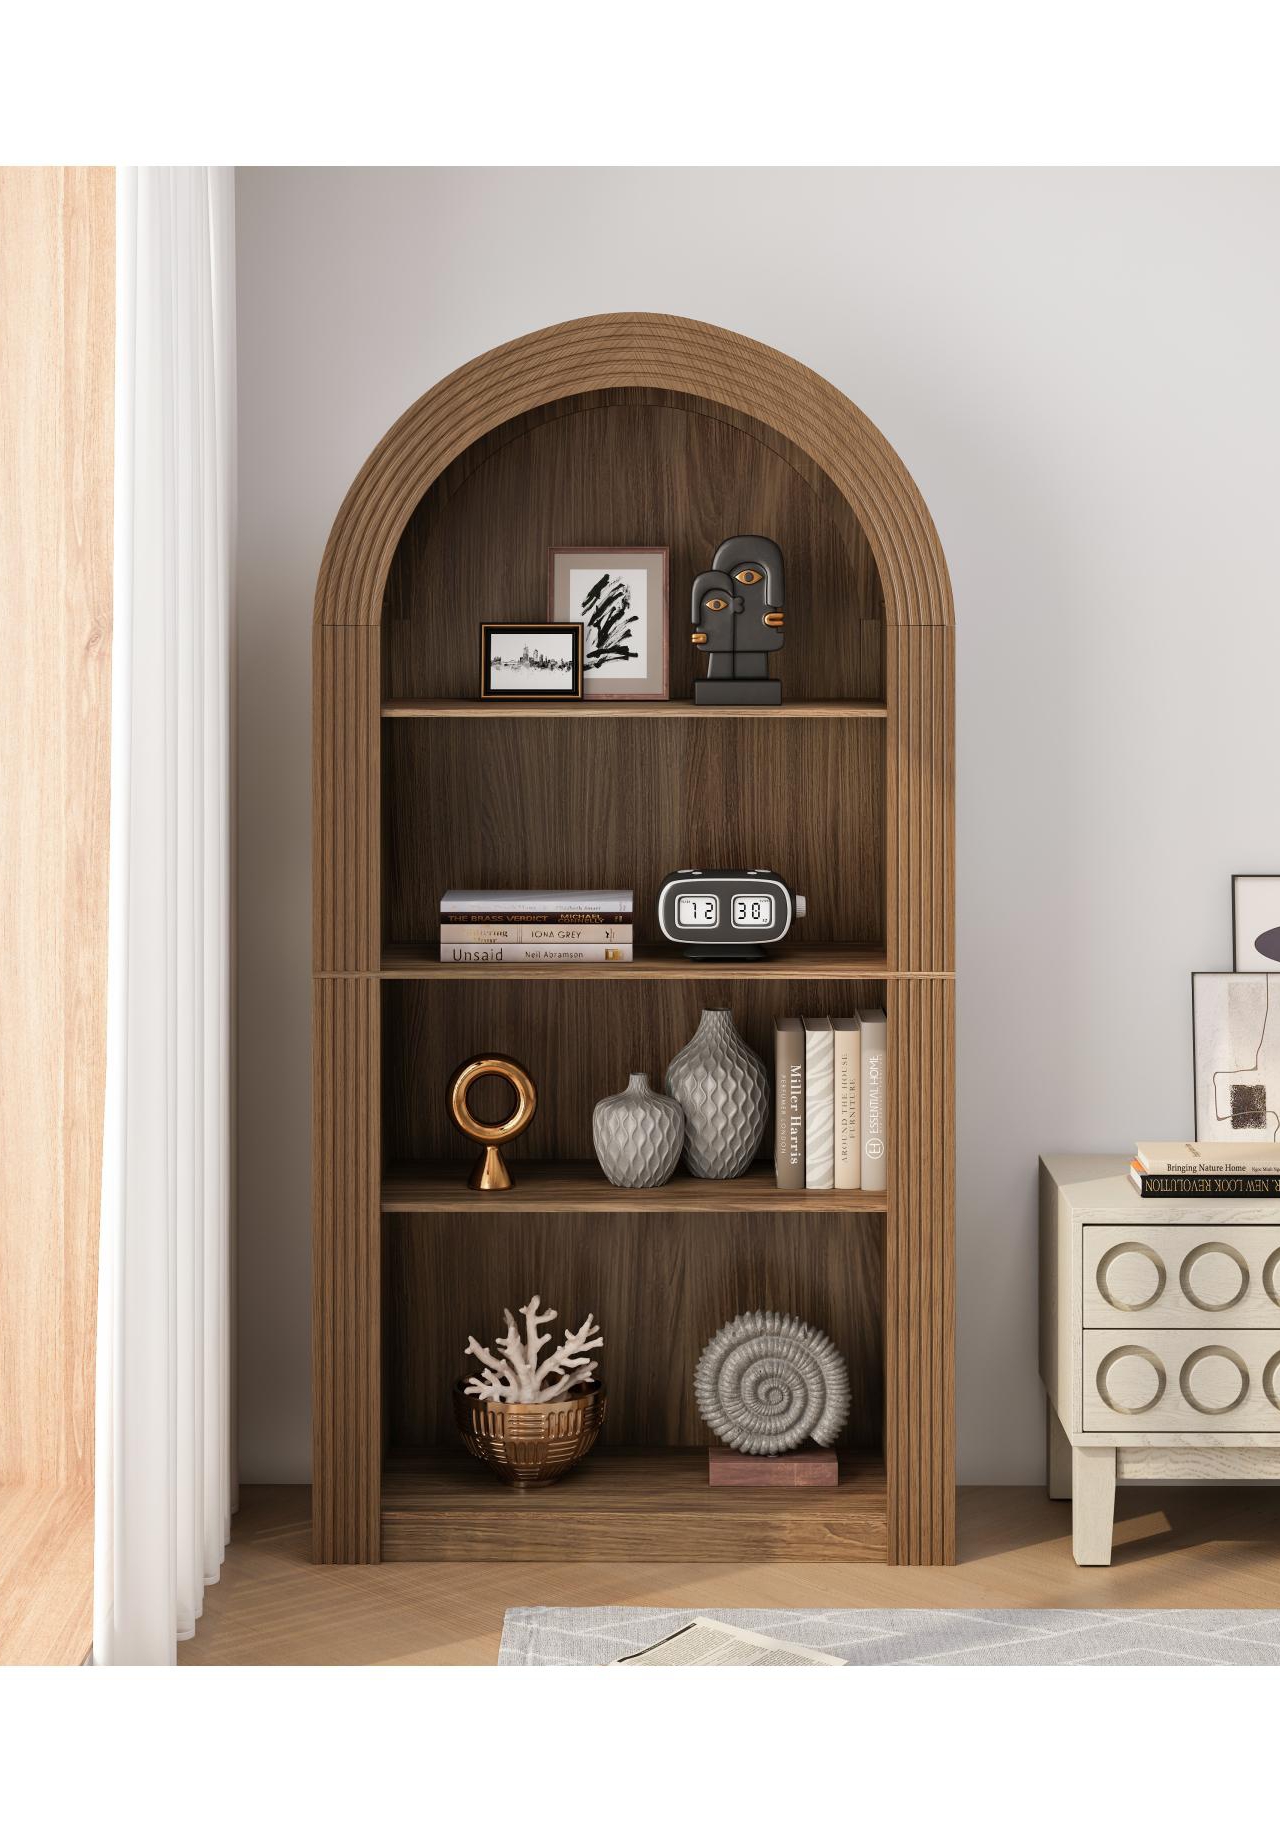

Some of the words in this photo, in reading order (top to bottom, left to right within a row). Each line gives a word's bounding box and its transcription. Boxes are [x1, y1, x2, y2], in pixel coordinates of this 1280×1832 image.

[738, 902, 761, 920] 30
[452, 947, 504, 961] Unsaid
[525, 951, 541, 959] Neil
[543, 951, 584, 959] Abramson
[869, 1055, 879, 1085] HOME
[790, 1065, 802, 1111] Miller
[869, 1087, 879, 1134] ESSENTIAL
[790, 1116, 802, 1165] Harris
[1167, 1163, 1197, 1173] Bringing
[1199, 1163, 1224, 1172] Nature
[1225, 1163, 1247, 1172] Home
[1145, 1179, 1211, 1192] REVOLUTION
[1215, 1179, 1243, 1192] LOOK
[1246, 1179, 1269, 1192] NEW
